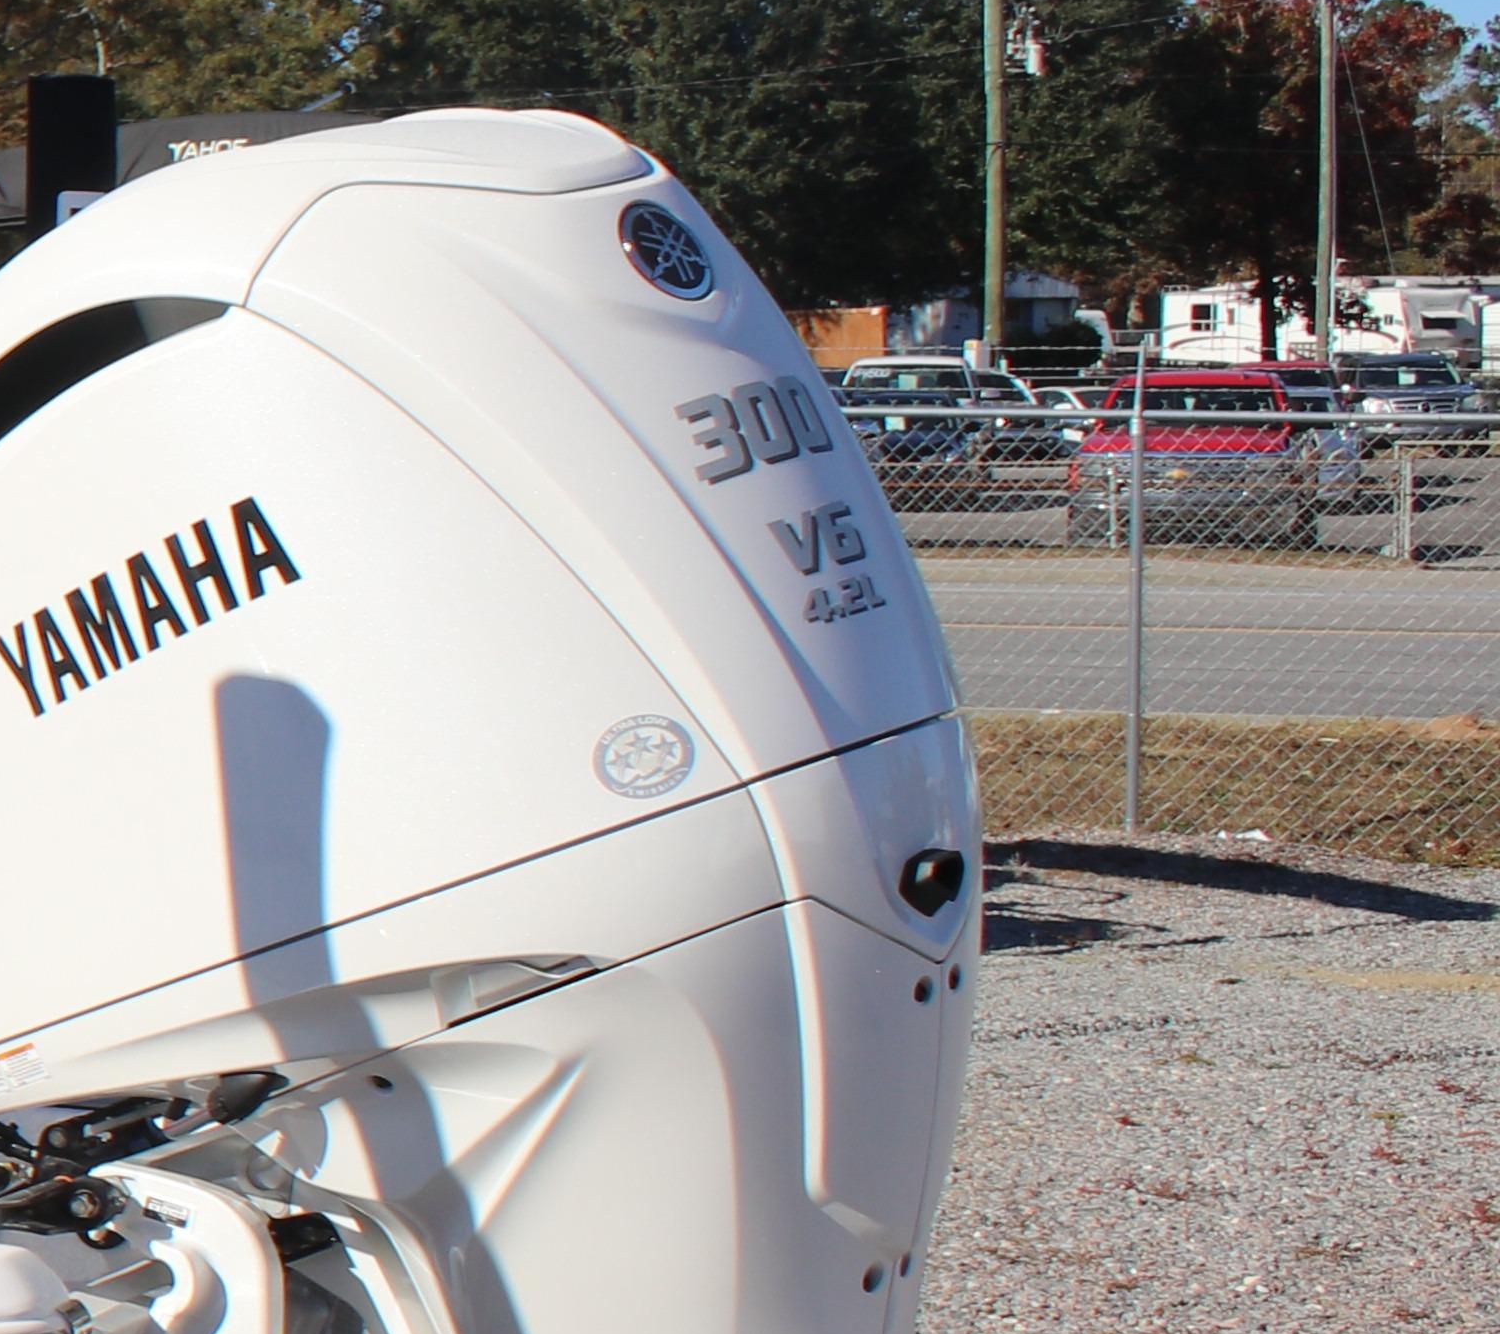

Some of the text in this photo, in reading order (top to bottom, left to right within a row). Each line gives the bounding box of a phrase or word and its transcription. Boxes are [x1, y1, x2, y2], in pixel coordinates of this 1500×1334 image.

[674, 374, 834, 486] 300
[765, 500, 867, 576] V6
[802, 572, 886, 624] 4.2L
